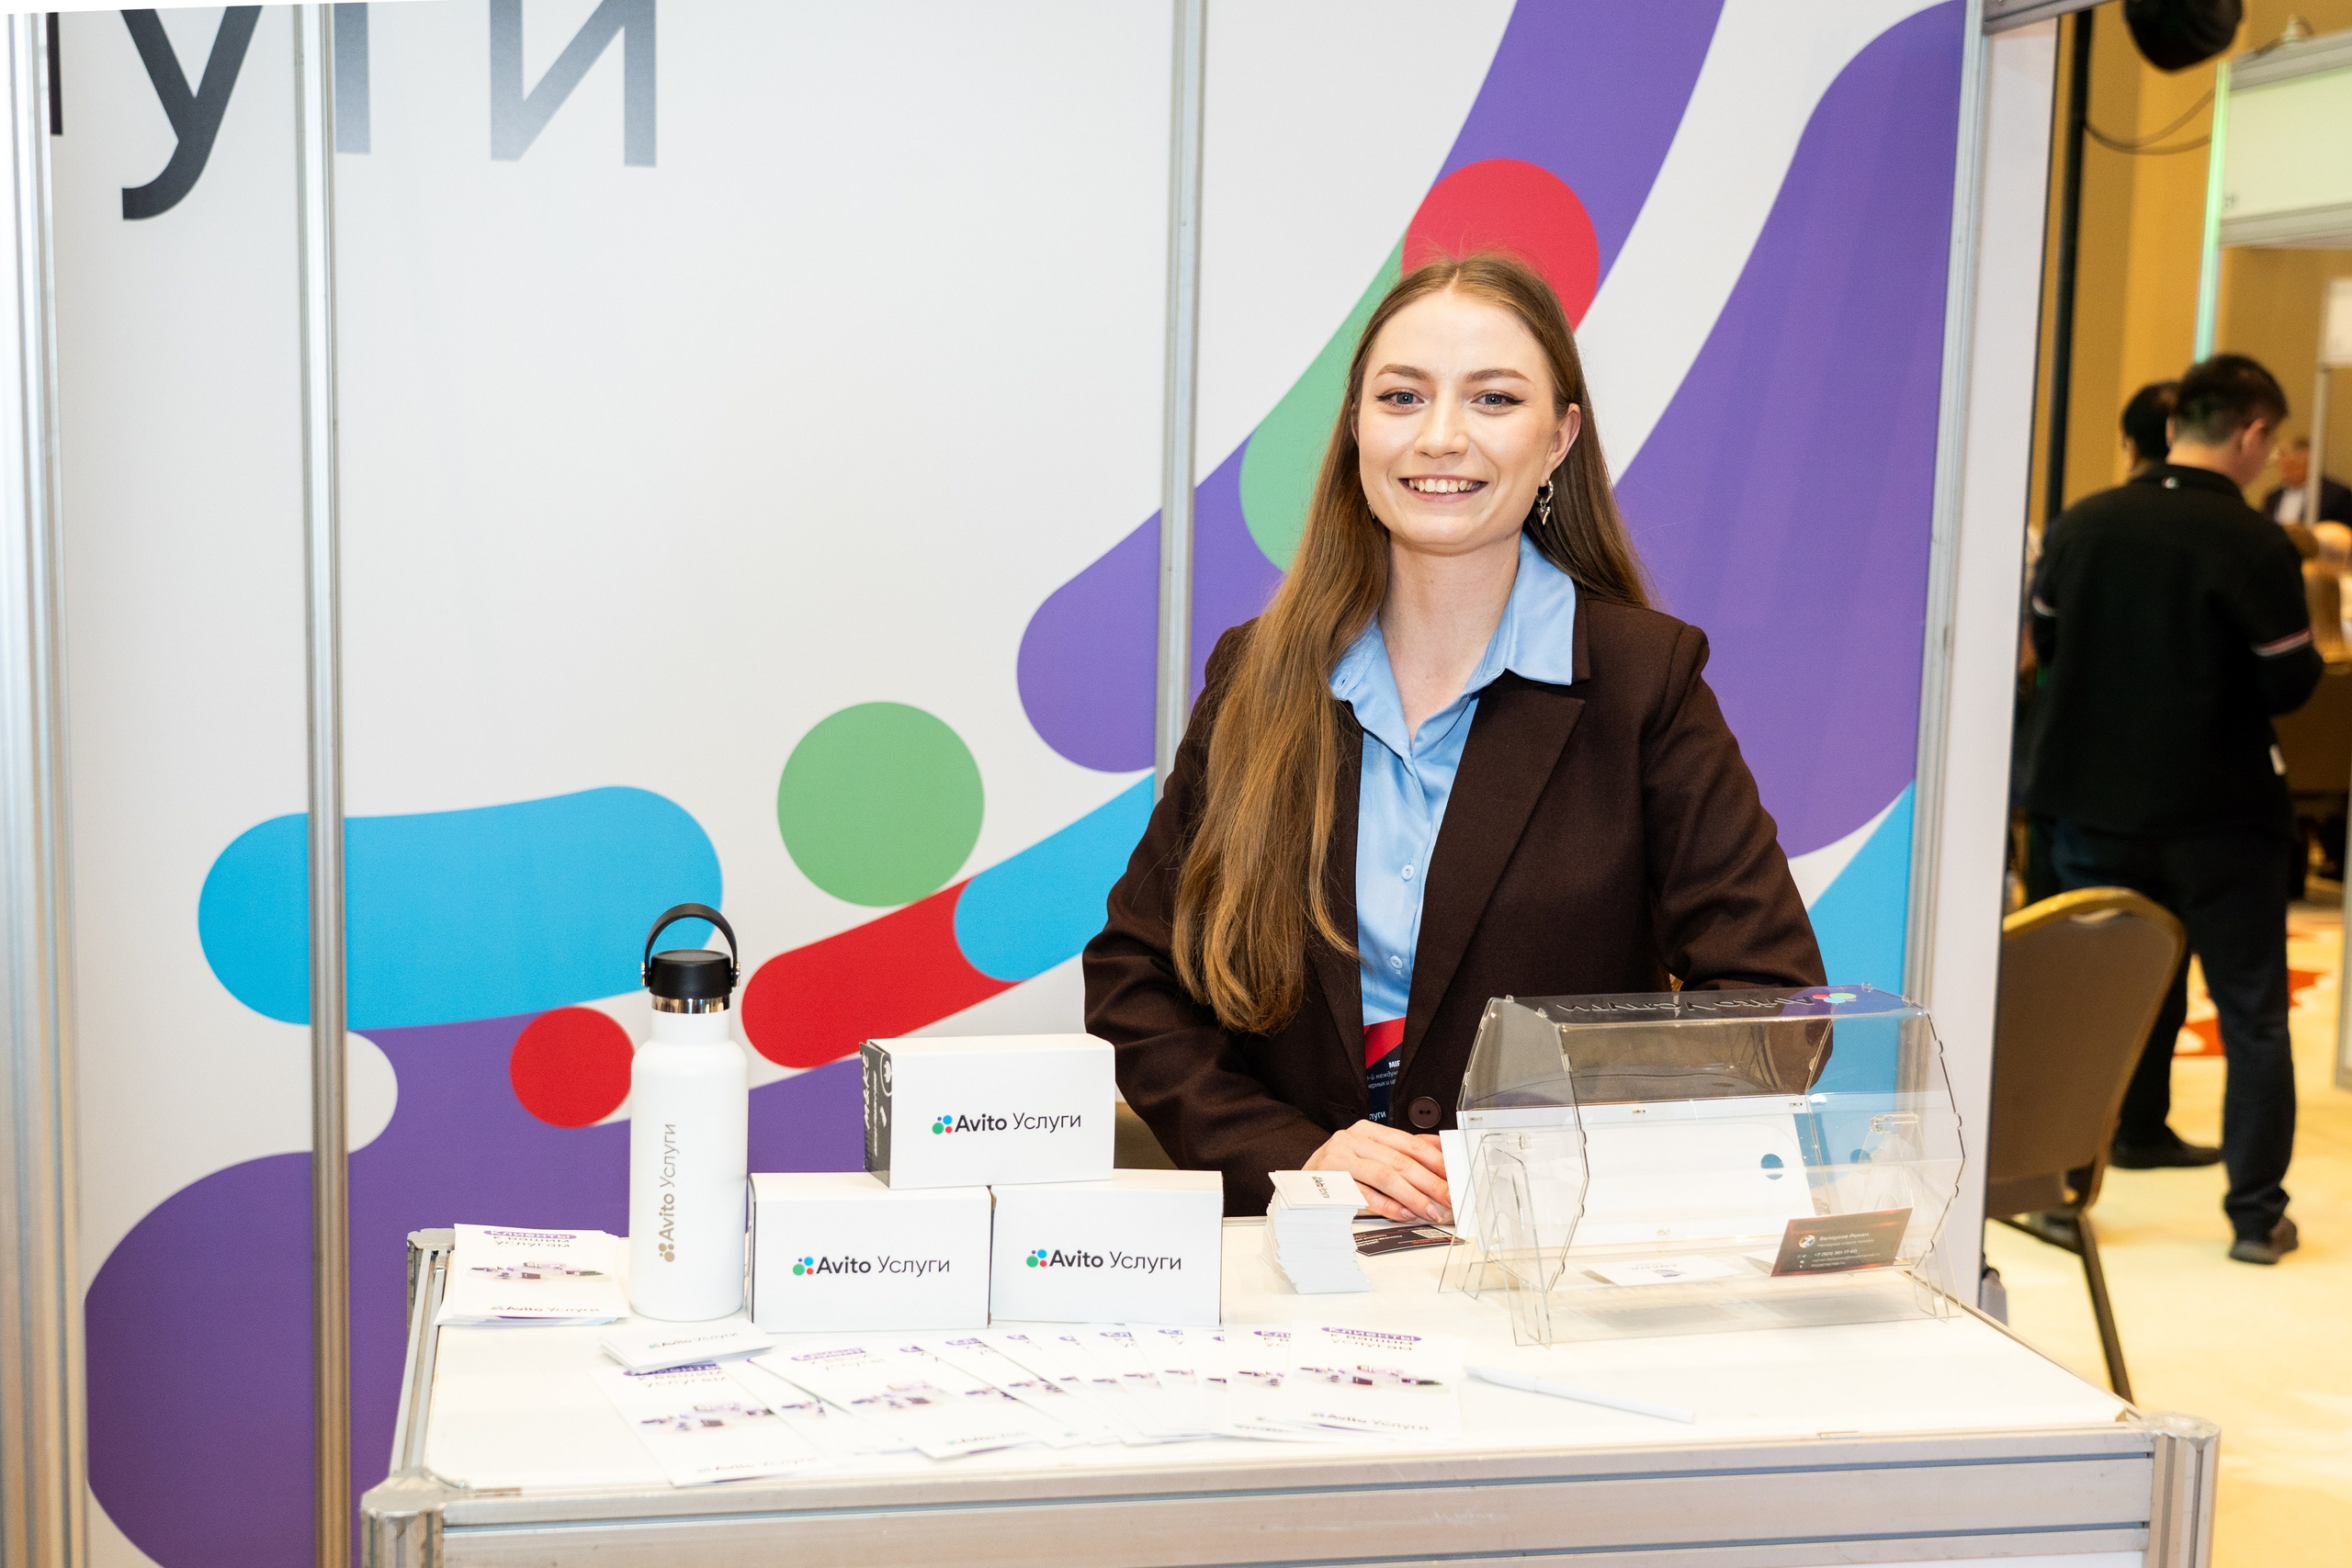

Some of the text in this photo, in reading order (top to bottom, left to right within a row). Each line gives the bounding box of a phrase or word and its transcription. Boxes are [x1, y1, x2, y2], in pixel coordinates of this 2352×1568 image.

[955, 1112, 1081, 1134] Avito Услуги
[659, 1123, 680, 1242] Avito Услуги
[816, 1255, 950, 1278] Avito Услуги
[1048, 1249, 1182, 1274] Avito Услуги
